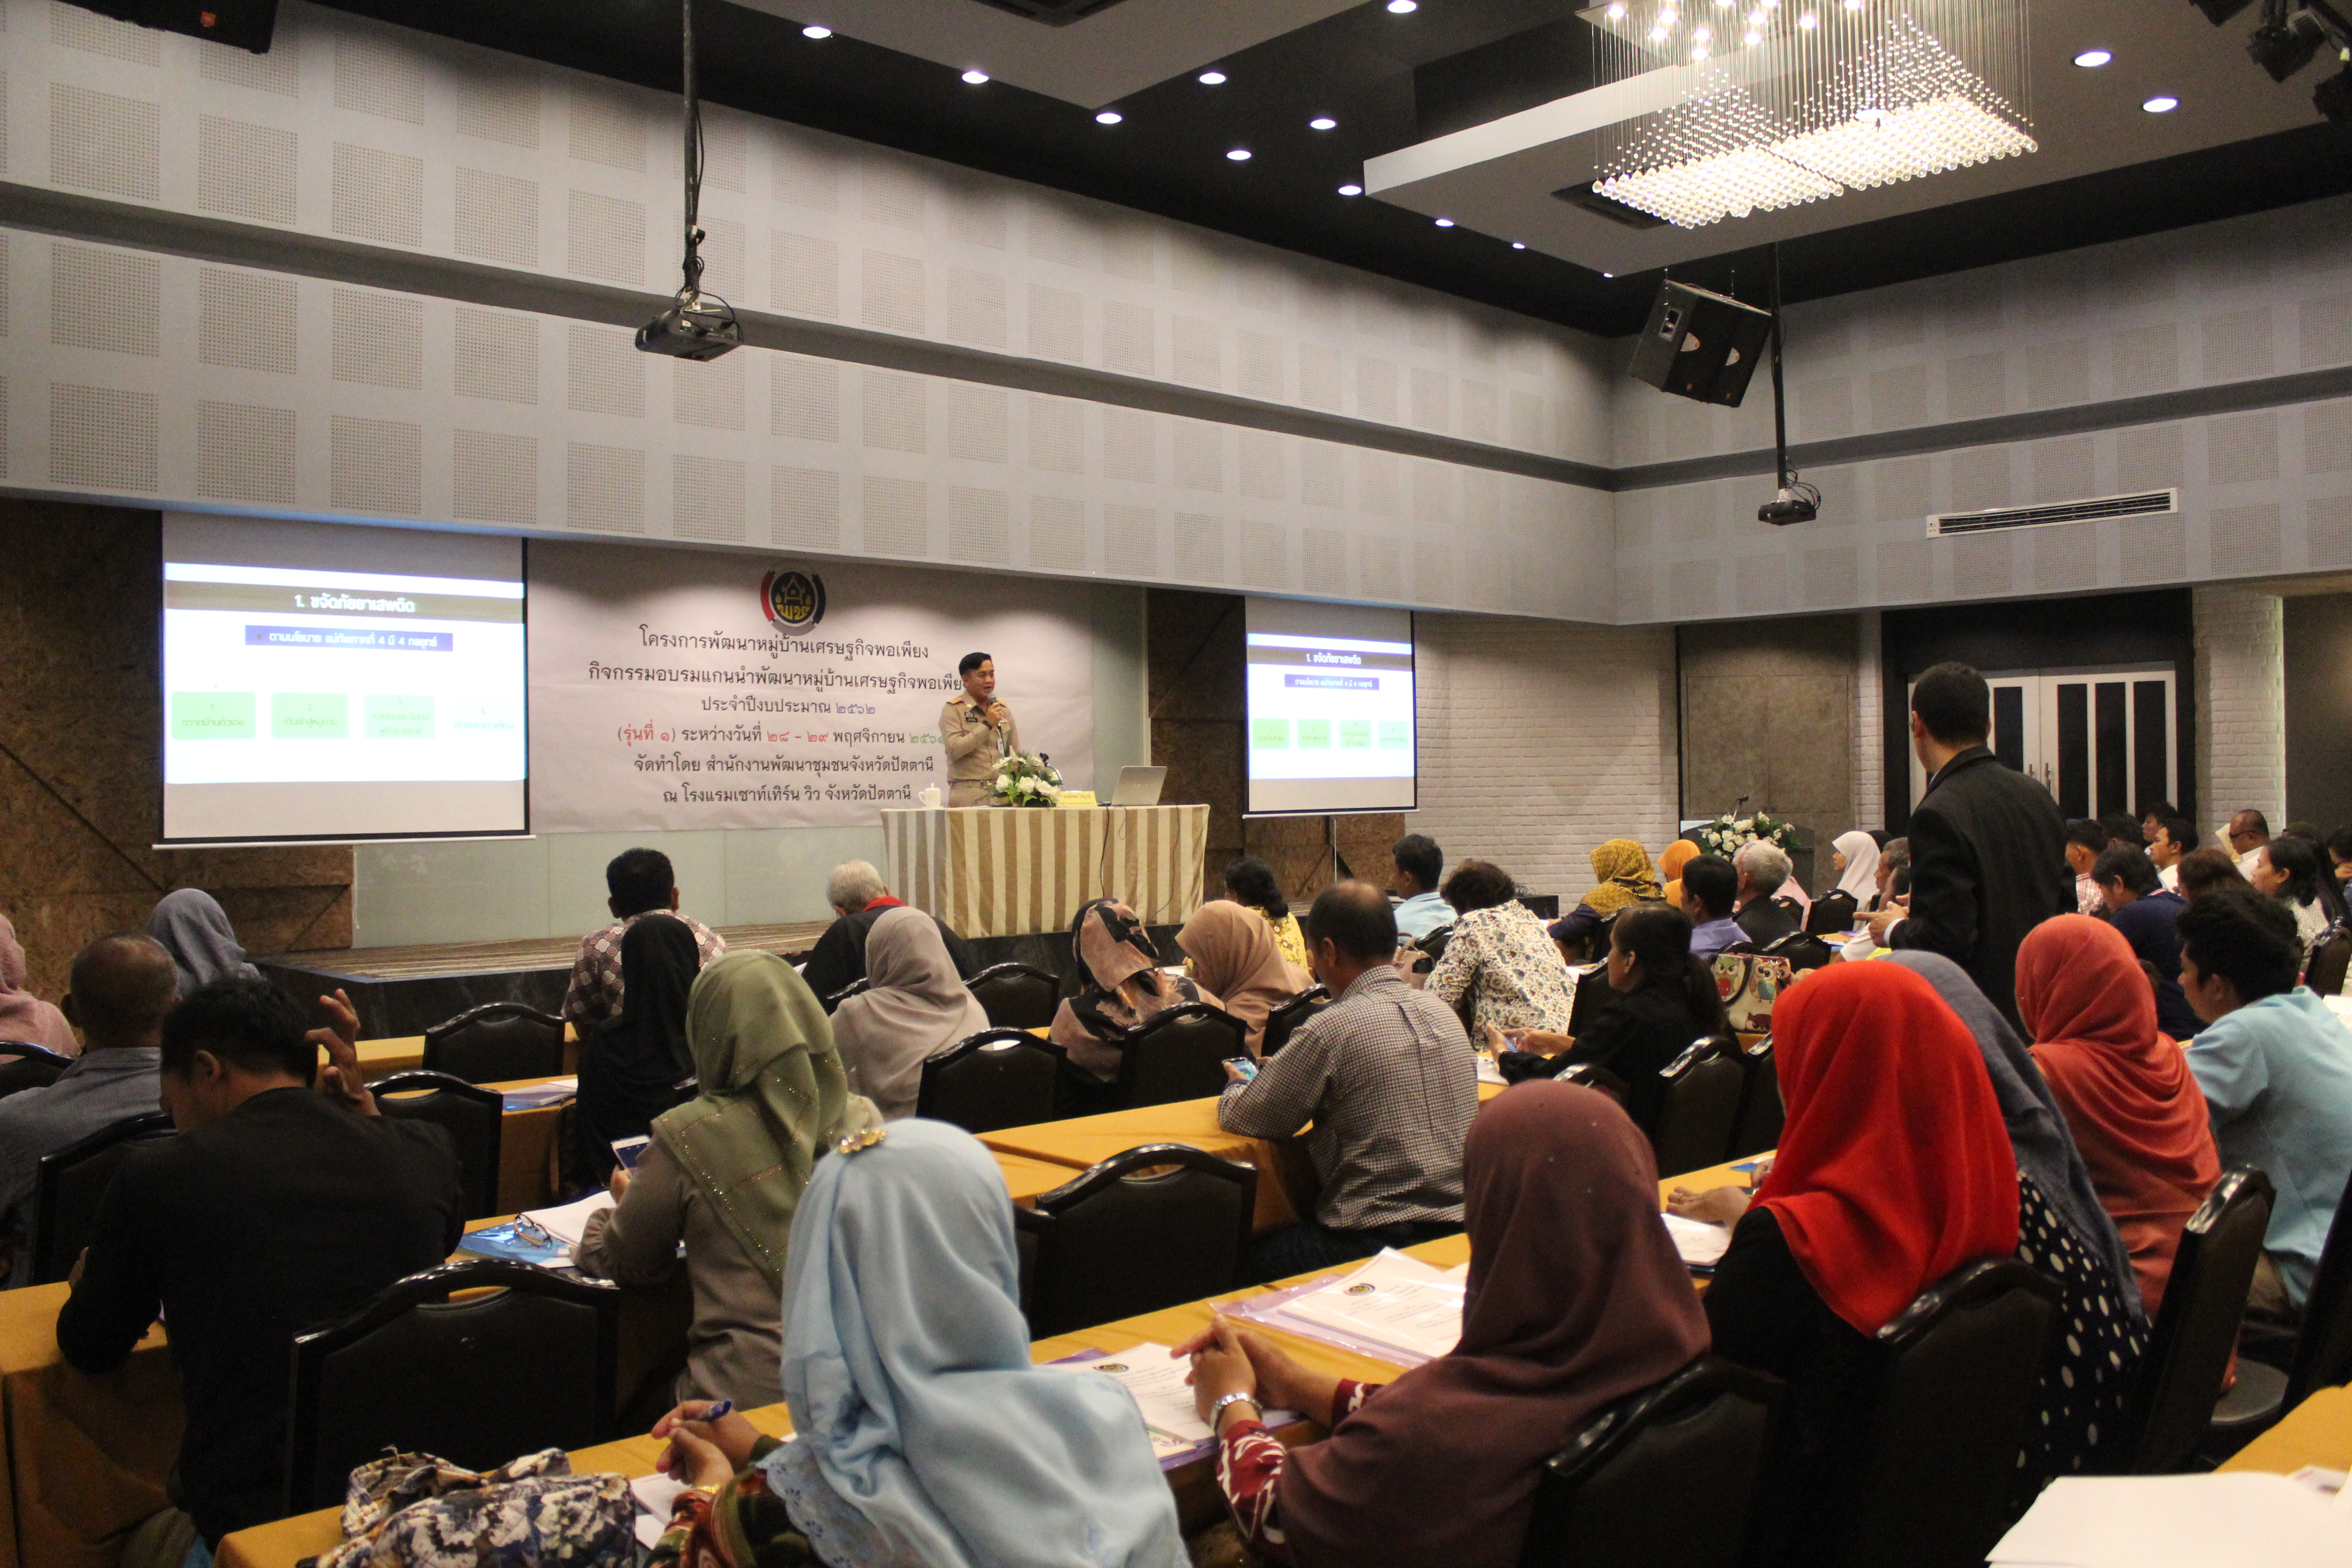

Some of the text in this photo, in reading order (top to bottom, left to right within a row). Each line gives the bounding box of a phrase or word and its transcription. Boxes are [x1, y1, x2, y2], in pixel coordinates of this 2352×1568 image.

[294, 593, 415, 612] 1. ขจัดภัยยาเสพติด
[269, 631, 322, 642] ตามนโยบาย
[378, 637, 385, 645] 4
[388, 635, 395, 646] มี
[398, 637, 405, 646] 4
[639, 624, 928, 661] โครงการพัฒนาหมู่บ้านเศรษฐกิจพอเพียง
[589, 661, 964, 694] กิจกรรมอบรมแกนนำพัฒนาหมู่บ้านเศรษฐกิจพอเพีย
[701, 695, 875, 714] ประจำปีงบประมาณ ๒๕๖๒
[617, 719, 654, 747] (รุ่นที่
[681, 720, 762, 742] ระหว่างวันที่
[767, 730, 790, 742] ๒๘
[807, 731, 828, 743] ๒๙
[833, 728, 905, 748] พฤศจิกายน
[634, 751, 933, 778] จัดทำโดย สำนักงานพัฒนาชุมชนจังหวัดปัตตานี
[663, 782, 911, 803] ณ โรงแรมเซาท์เทิร์น วิว จังหวัดปัตตานี
